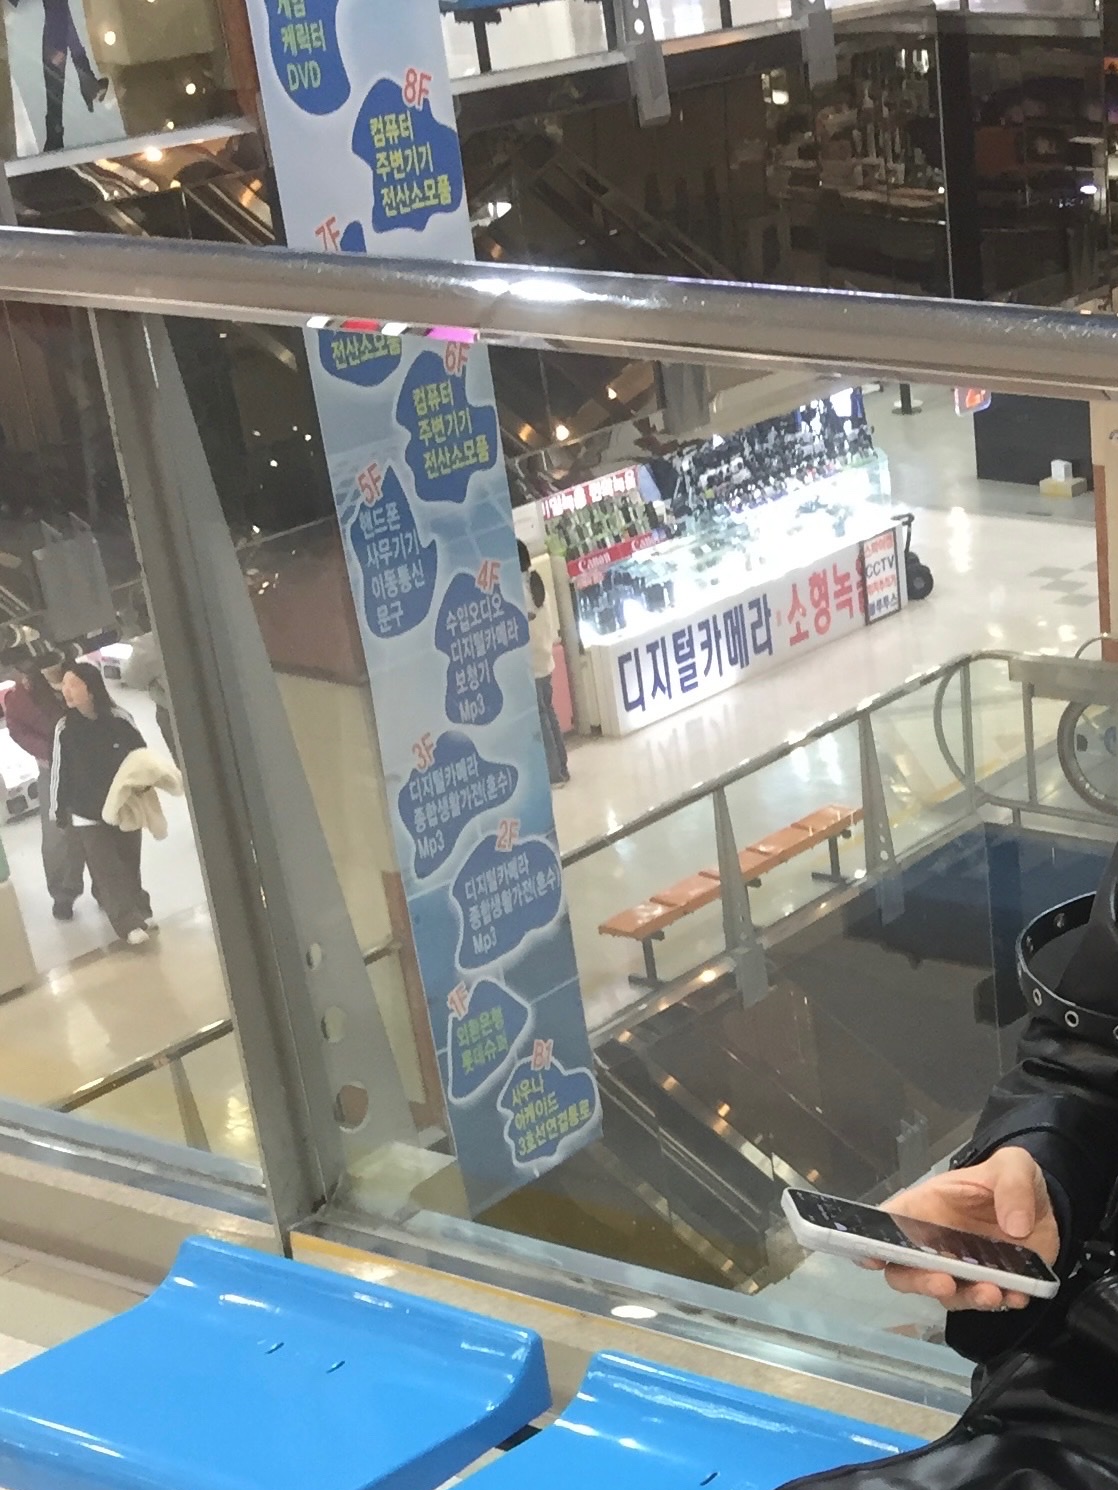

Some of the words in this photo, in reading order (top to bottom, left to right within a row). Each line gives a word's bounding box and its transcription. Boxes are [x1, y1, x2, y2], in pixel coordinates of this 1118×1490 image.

[287, 60, 322, 91] DVD
[404, 68, 432, 106] 8F
[369, 110, 414, 148] 컴퓨터
[375, 142, 433, 182] 주변기기
[380, 174, 451, 217] 전산소모품
[315, 216, 341, 251] 7F
[445, 341, 471, 374] 6F
[412, 379, 454, 416] 컴퓨터
[418, 408, 472, 446] 주변기기
[423, 434, 490, 480] 전산소모품
[357, 462, 382, 504] 5F
[367, 528, 420, 569] 사무기기
[578, 551, 611, 573] Canon
[865, 554, 895, 579] CCTV
[371, 559, 425, 601] 이동통신
[476, 560, 500, 594] 4F
[376, 600, 404, 634] 문구
[446, 593, 504, 638] 수입오디오
[450, 617, 519, 665] 디지털카메라
[617, 593, 773, 712] 디지털카메라
[456, 658, 491, 695] 보청기
[458, 693, 486, 724] Mp3
[411, 732, 434, 770] 3F
[409, 752, 479, 803] 디지털카메라
[417, 829, 445, 860] Mp3
[496, 820, 519, 851] 2F
[512, 1073, 545, 1107] 사우나
[515, 1091, 558, 1131] 아케이드
